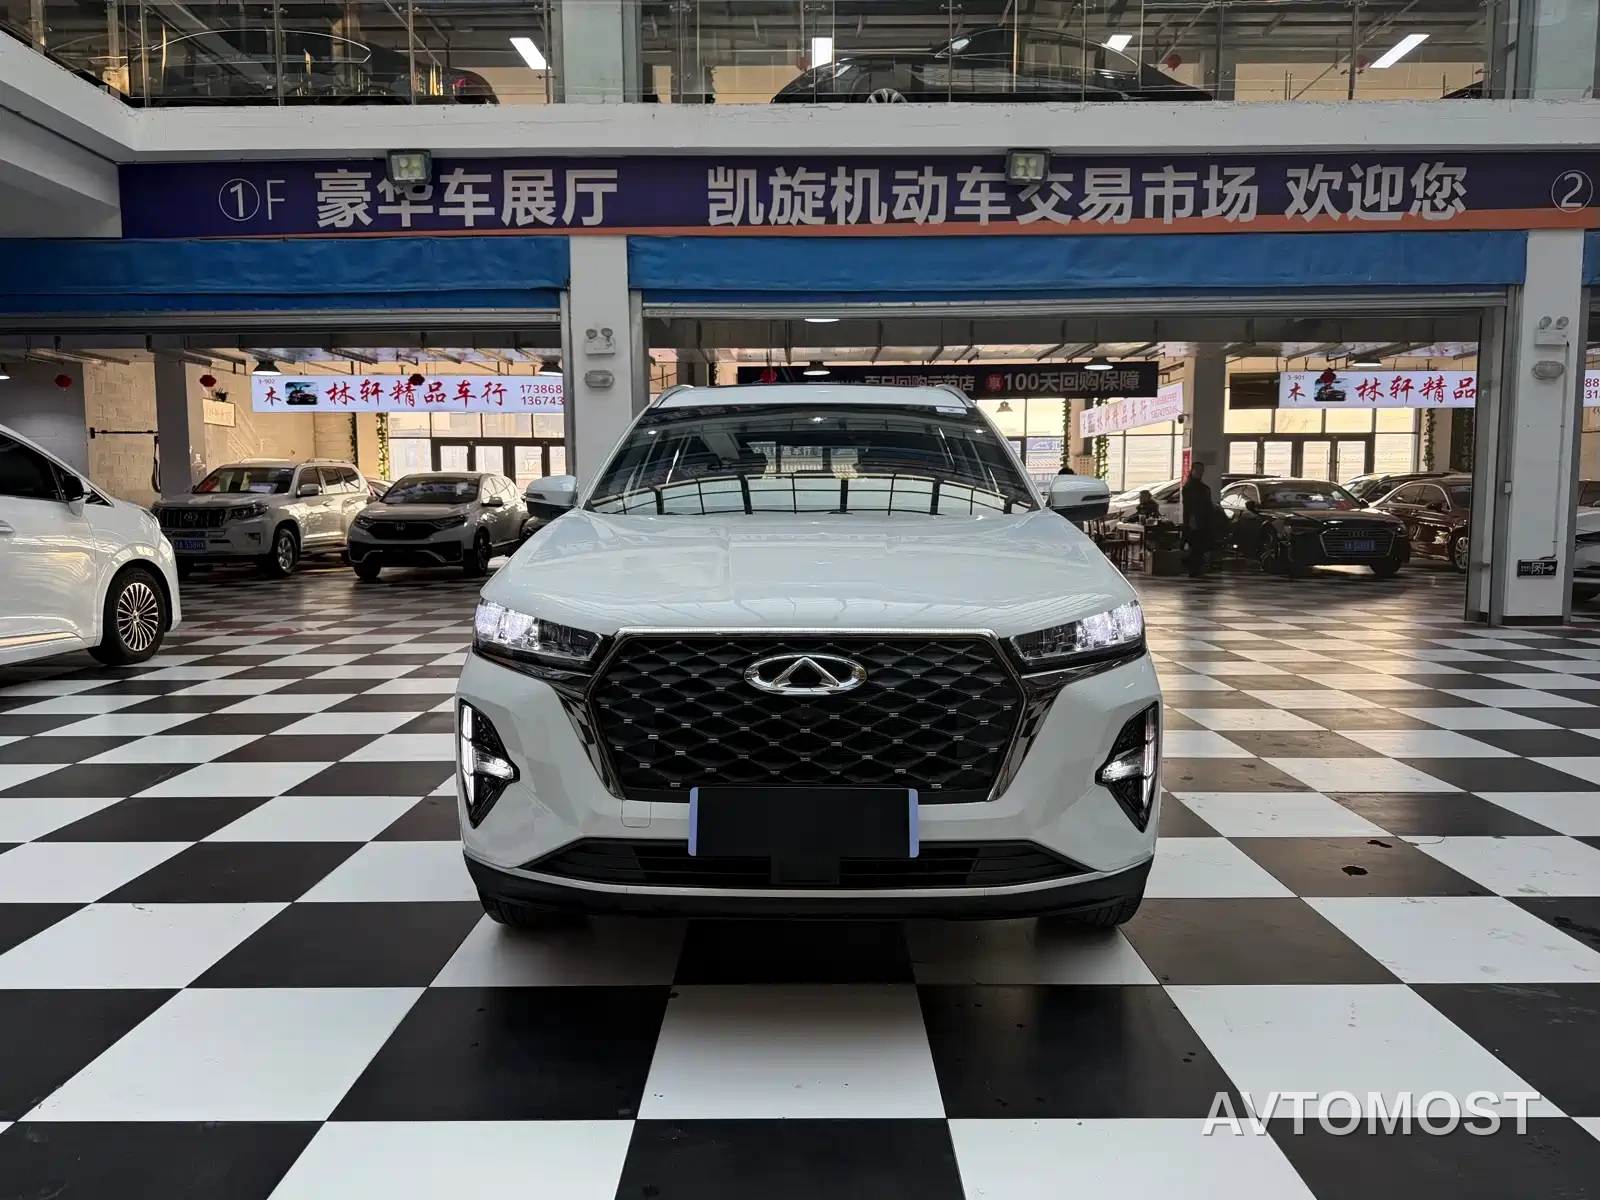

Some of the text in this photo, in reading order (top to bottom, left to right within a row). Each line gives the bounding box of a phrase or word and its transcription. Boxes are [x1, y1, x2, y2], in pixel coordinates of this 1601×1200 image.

[314, 168, 618, 228] 豪华车展厅
[707, 165, 1259, 226] 凯旋机动车交易市场
[1284, 162, 1468, 222] 欢迎您
[264, 379, 508, 408] 木 林轩精品车行
[519, 384, 563, 394] 173868
[1004, 370, 1141, 393] 100天回购保障
[1287, 375, 1477, 404] 木 林轩精品
[520, 396, 565, 406] 136743
